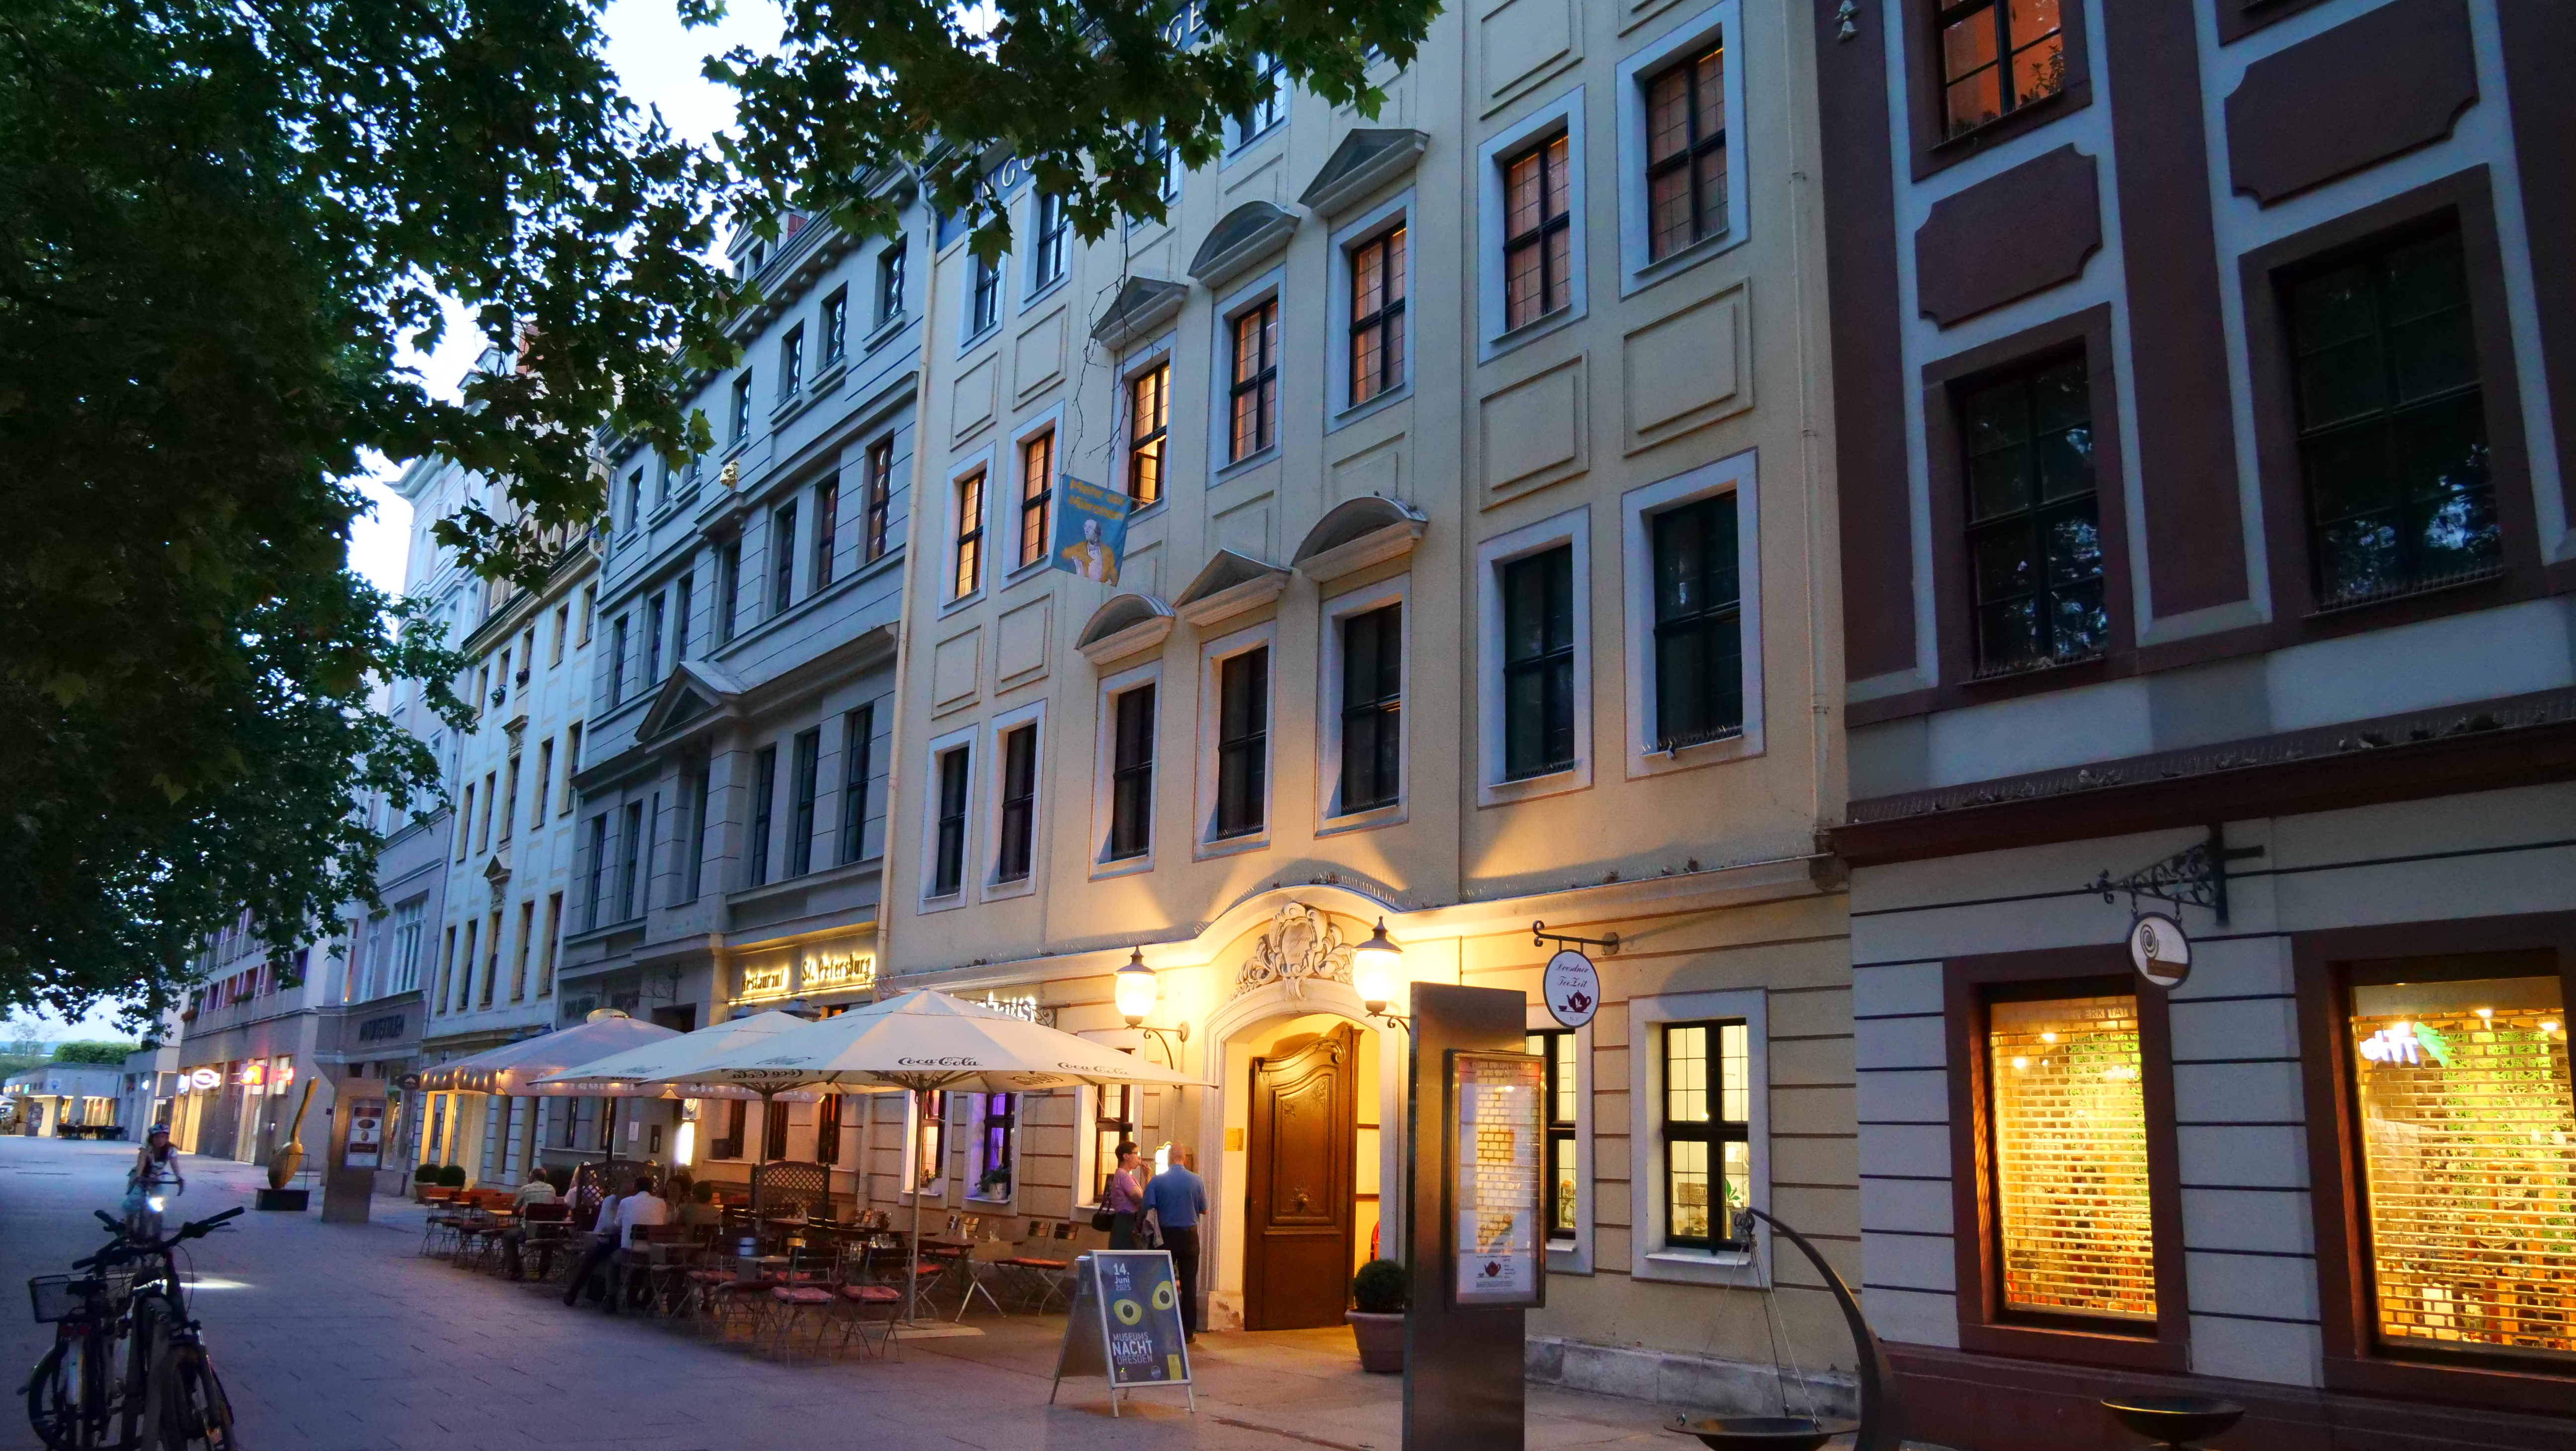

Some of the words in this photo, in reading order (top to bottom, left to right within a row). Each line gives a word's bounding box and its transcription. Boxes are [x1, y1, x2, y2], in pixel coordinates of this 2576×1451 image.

[1555, 961, 1589, 973] Dresdner
[741, 969, 784, 992] Restaurant
[897, 1056, 981, 1066] Coca-Cola
[1057, 1061, 1130, 1075] Coca-Cola
[1114, 1263, 1129, 1275] 14.
[1115, 1276, 1129, 1285] Juni
[1113, 1332, 1148, 1342] MUSEUMS
[1112, 1340, 1152, 1356] NACHT
[1117, 1354, 1153, 1365] DRESDEN
